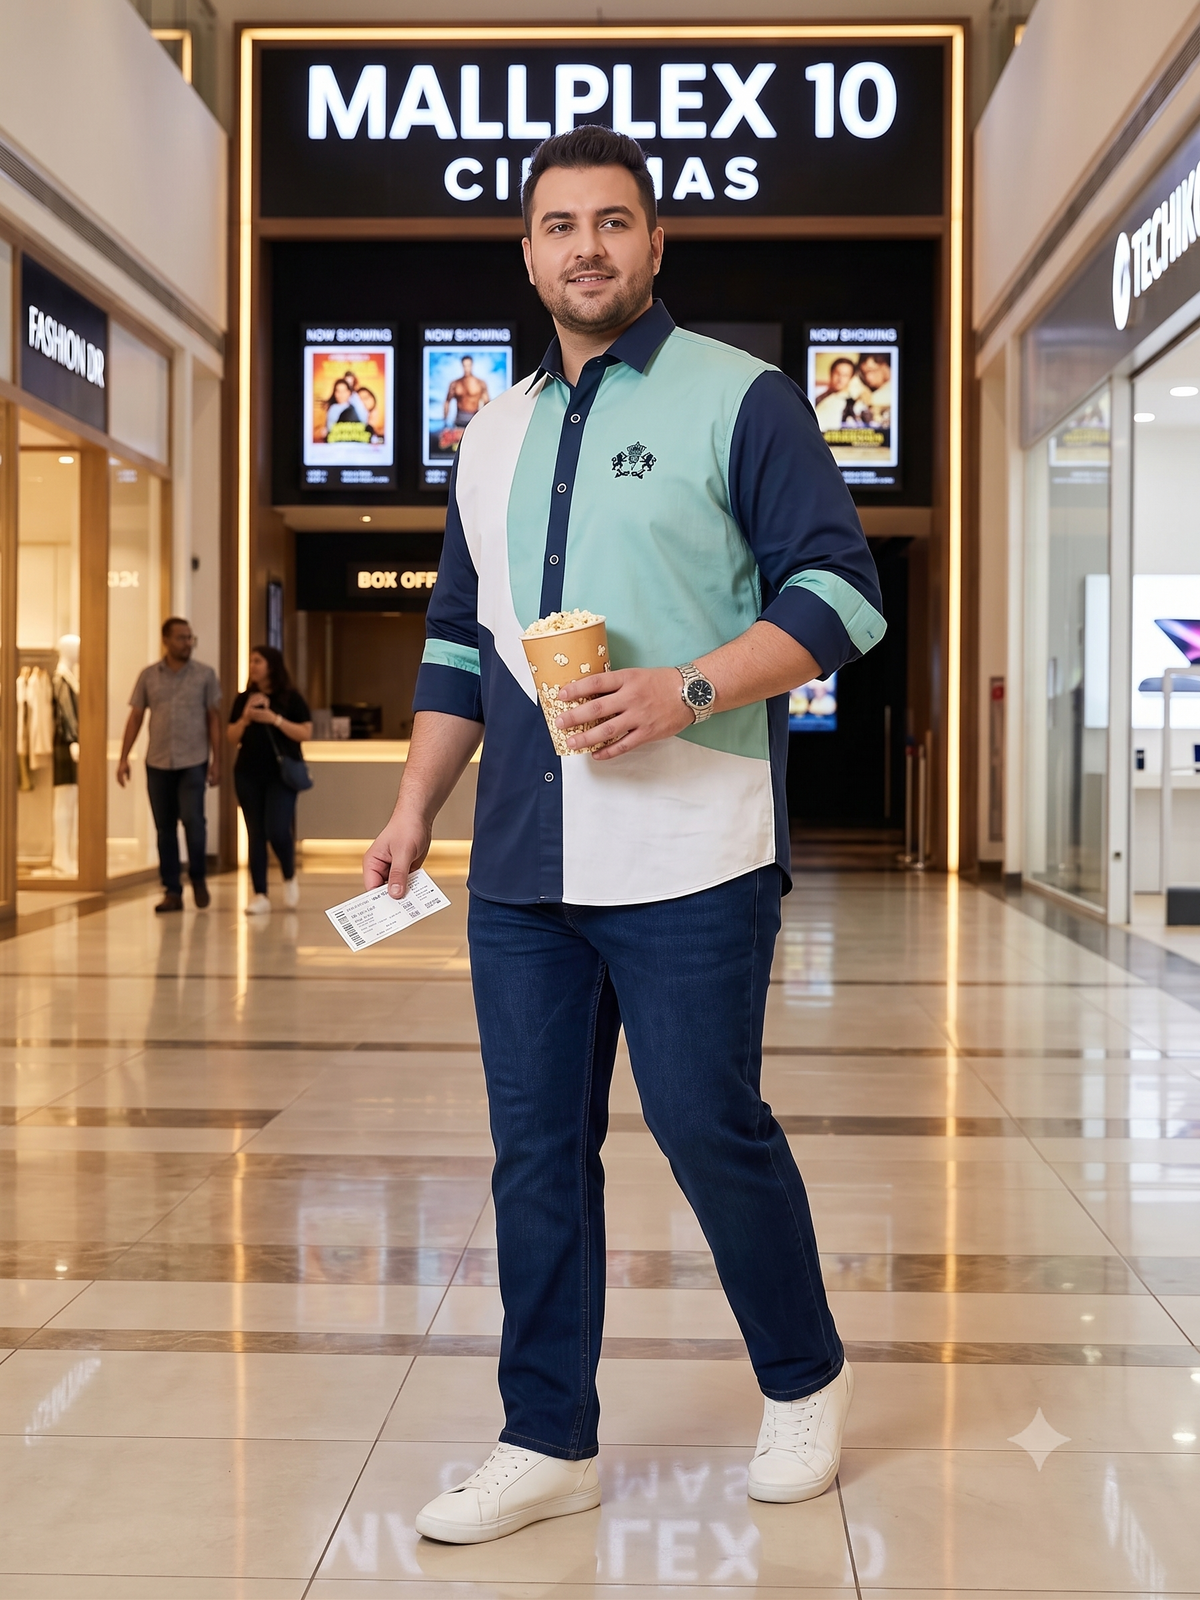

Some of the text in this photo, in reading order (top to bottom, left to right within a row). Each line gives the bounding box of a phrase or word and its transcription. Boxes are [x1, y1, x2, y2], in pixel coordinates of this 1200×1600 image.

[308, 62, 897, 140] MALLPLEX 10
[444, 157, 760, 203] CIAS
[306, 328, 335, 342] NOW
[424, 328, 453, 342] NOW
[809, 328, 839, 342] NOW
[28, 304, 105, 389] FASHION DR
[358, 571, 398, 589] BOX
